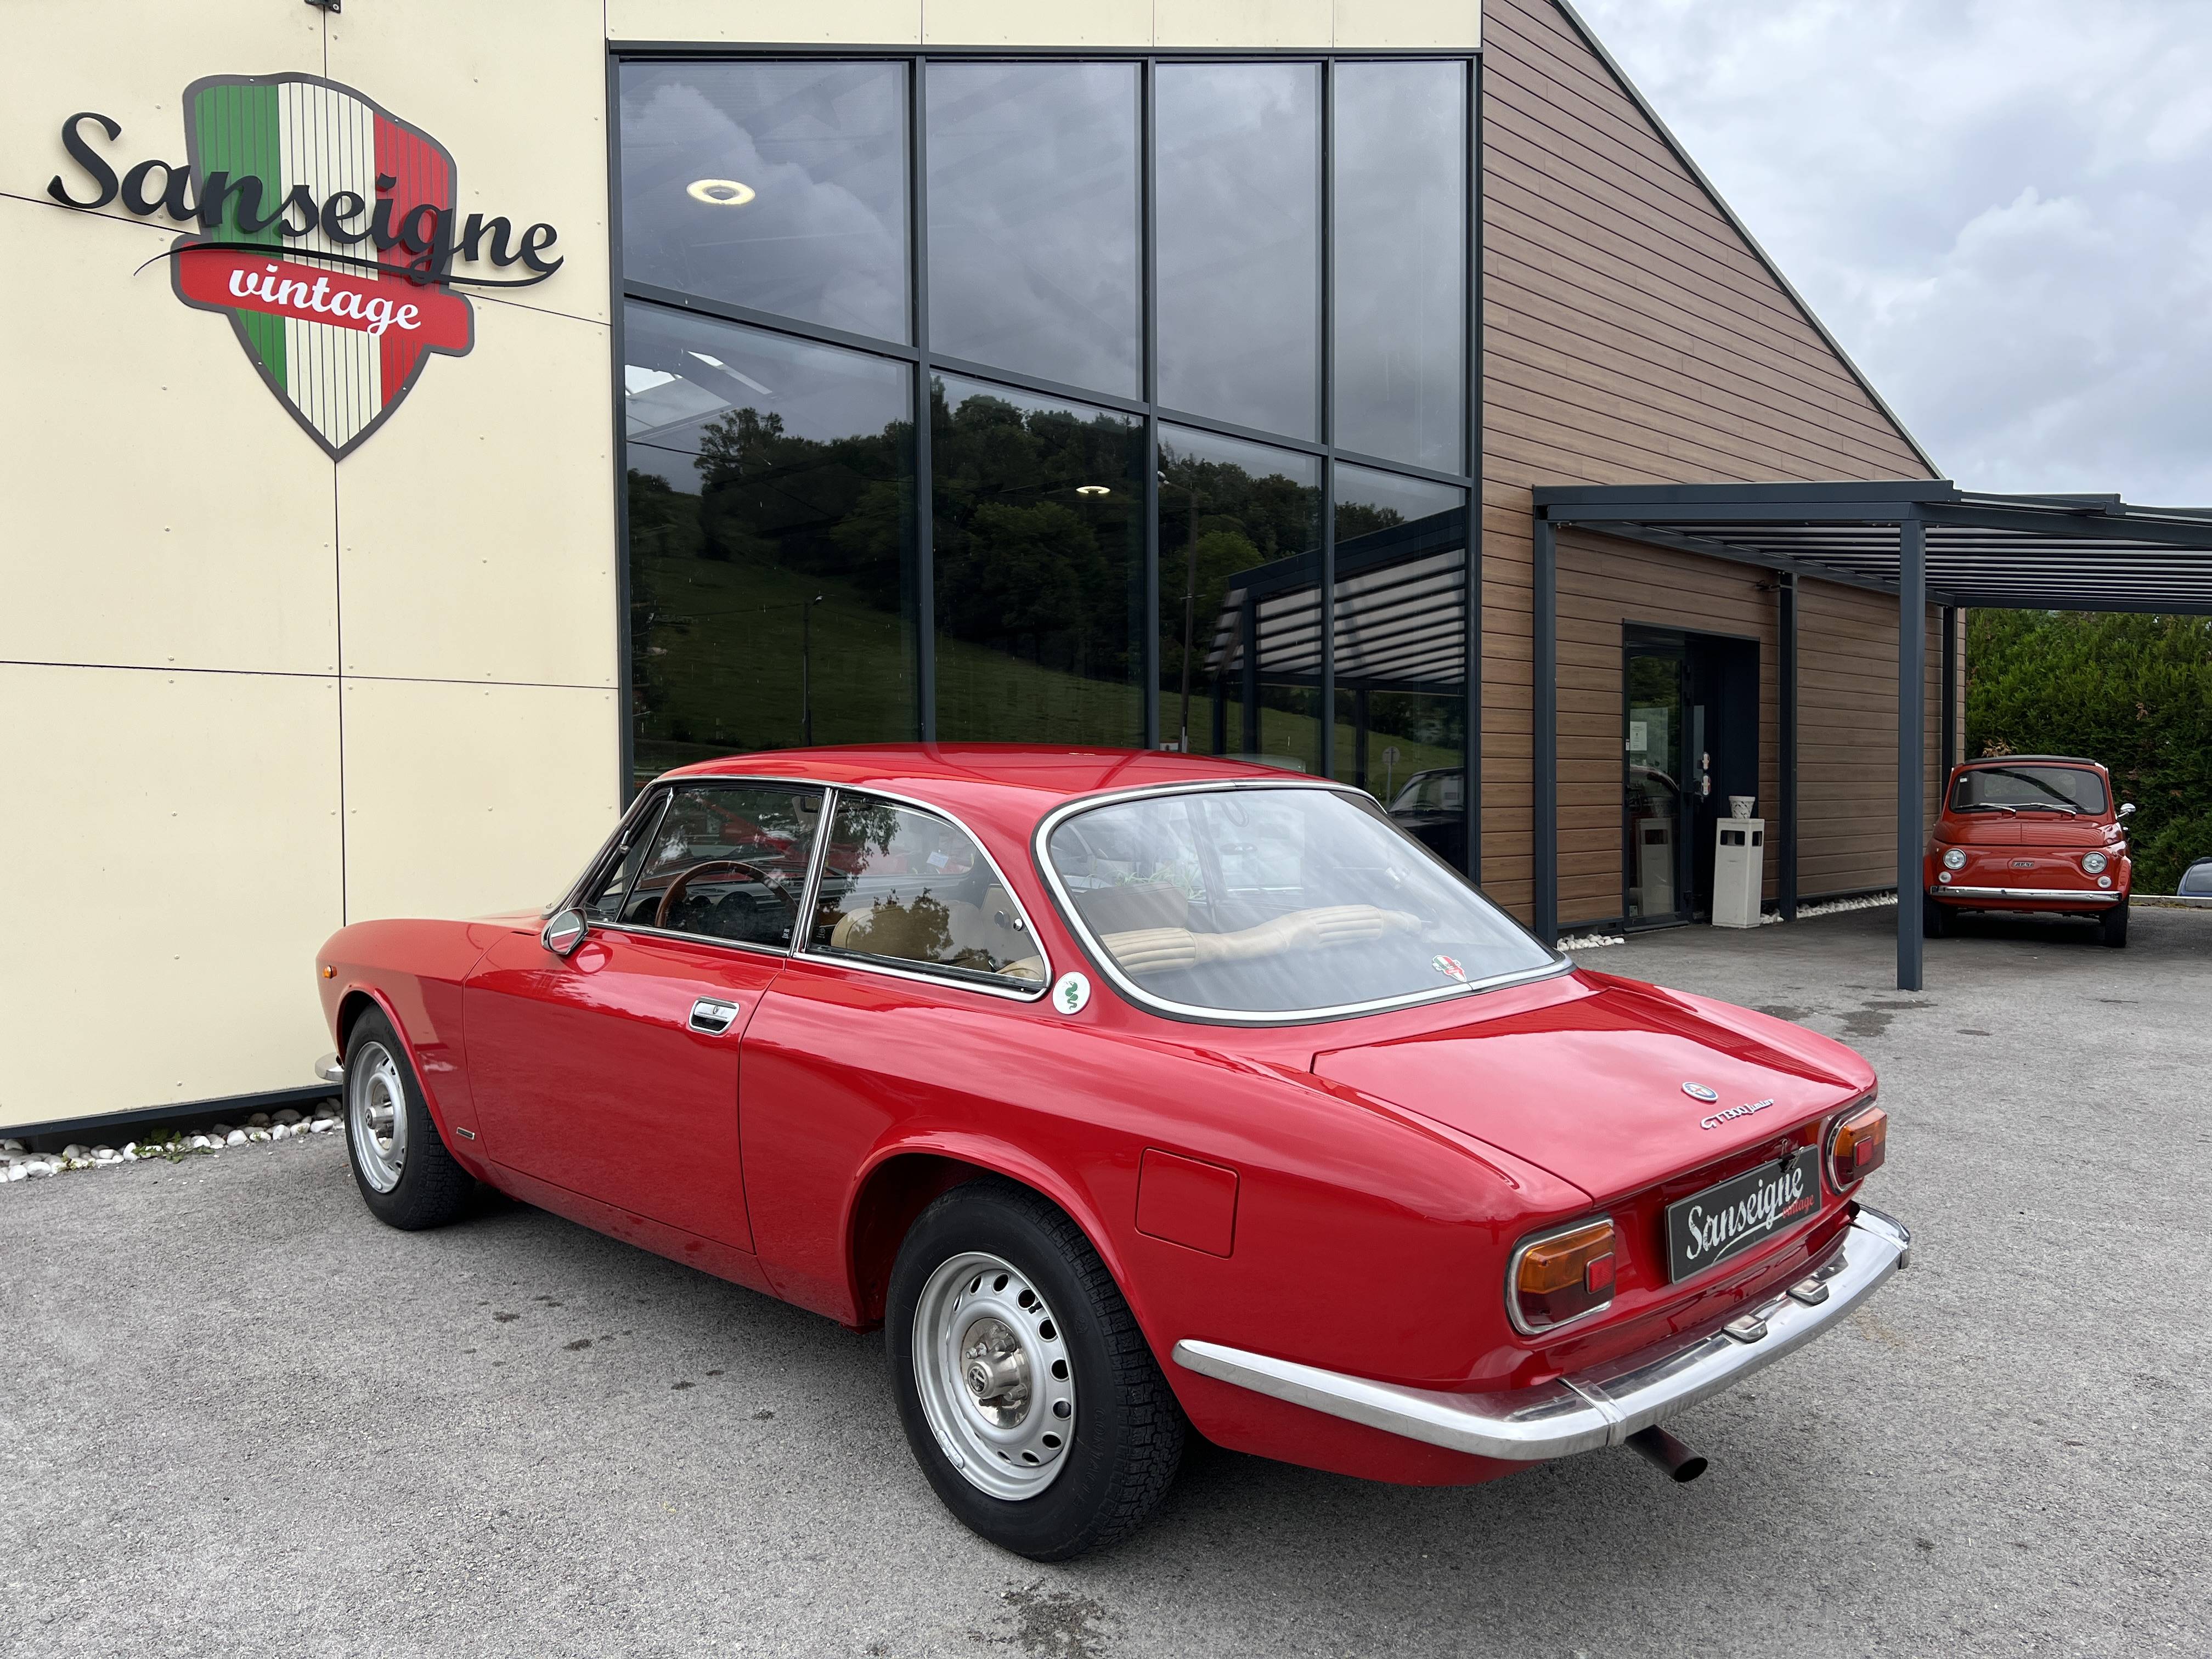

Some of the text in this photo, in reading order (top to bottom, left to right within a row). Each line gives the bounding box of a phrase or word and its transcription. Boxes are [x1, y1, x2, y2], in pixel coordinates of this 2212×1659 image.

[47, 111, 564, 286] Sanseigne
[229, 263, 421, 337] vintage
[1686, 1167, 1804, 1260] Sanseigne
